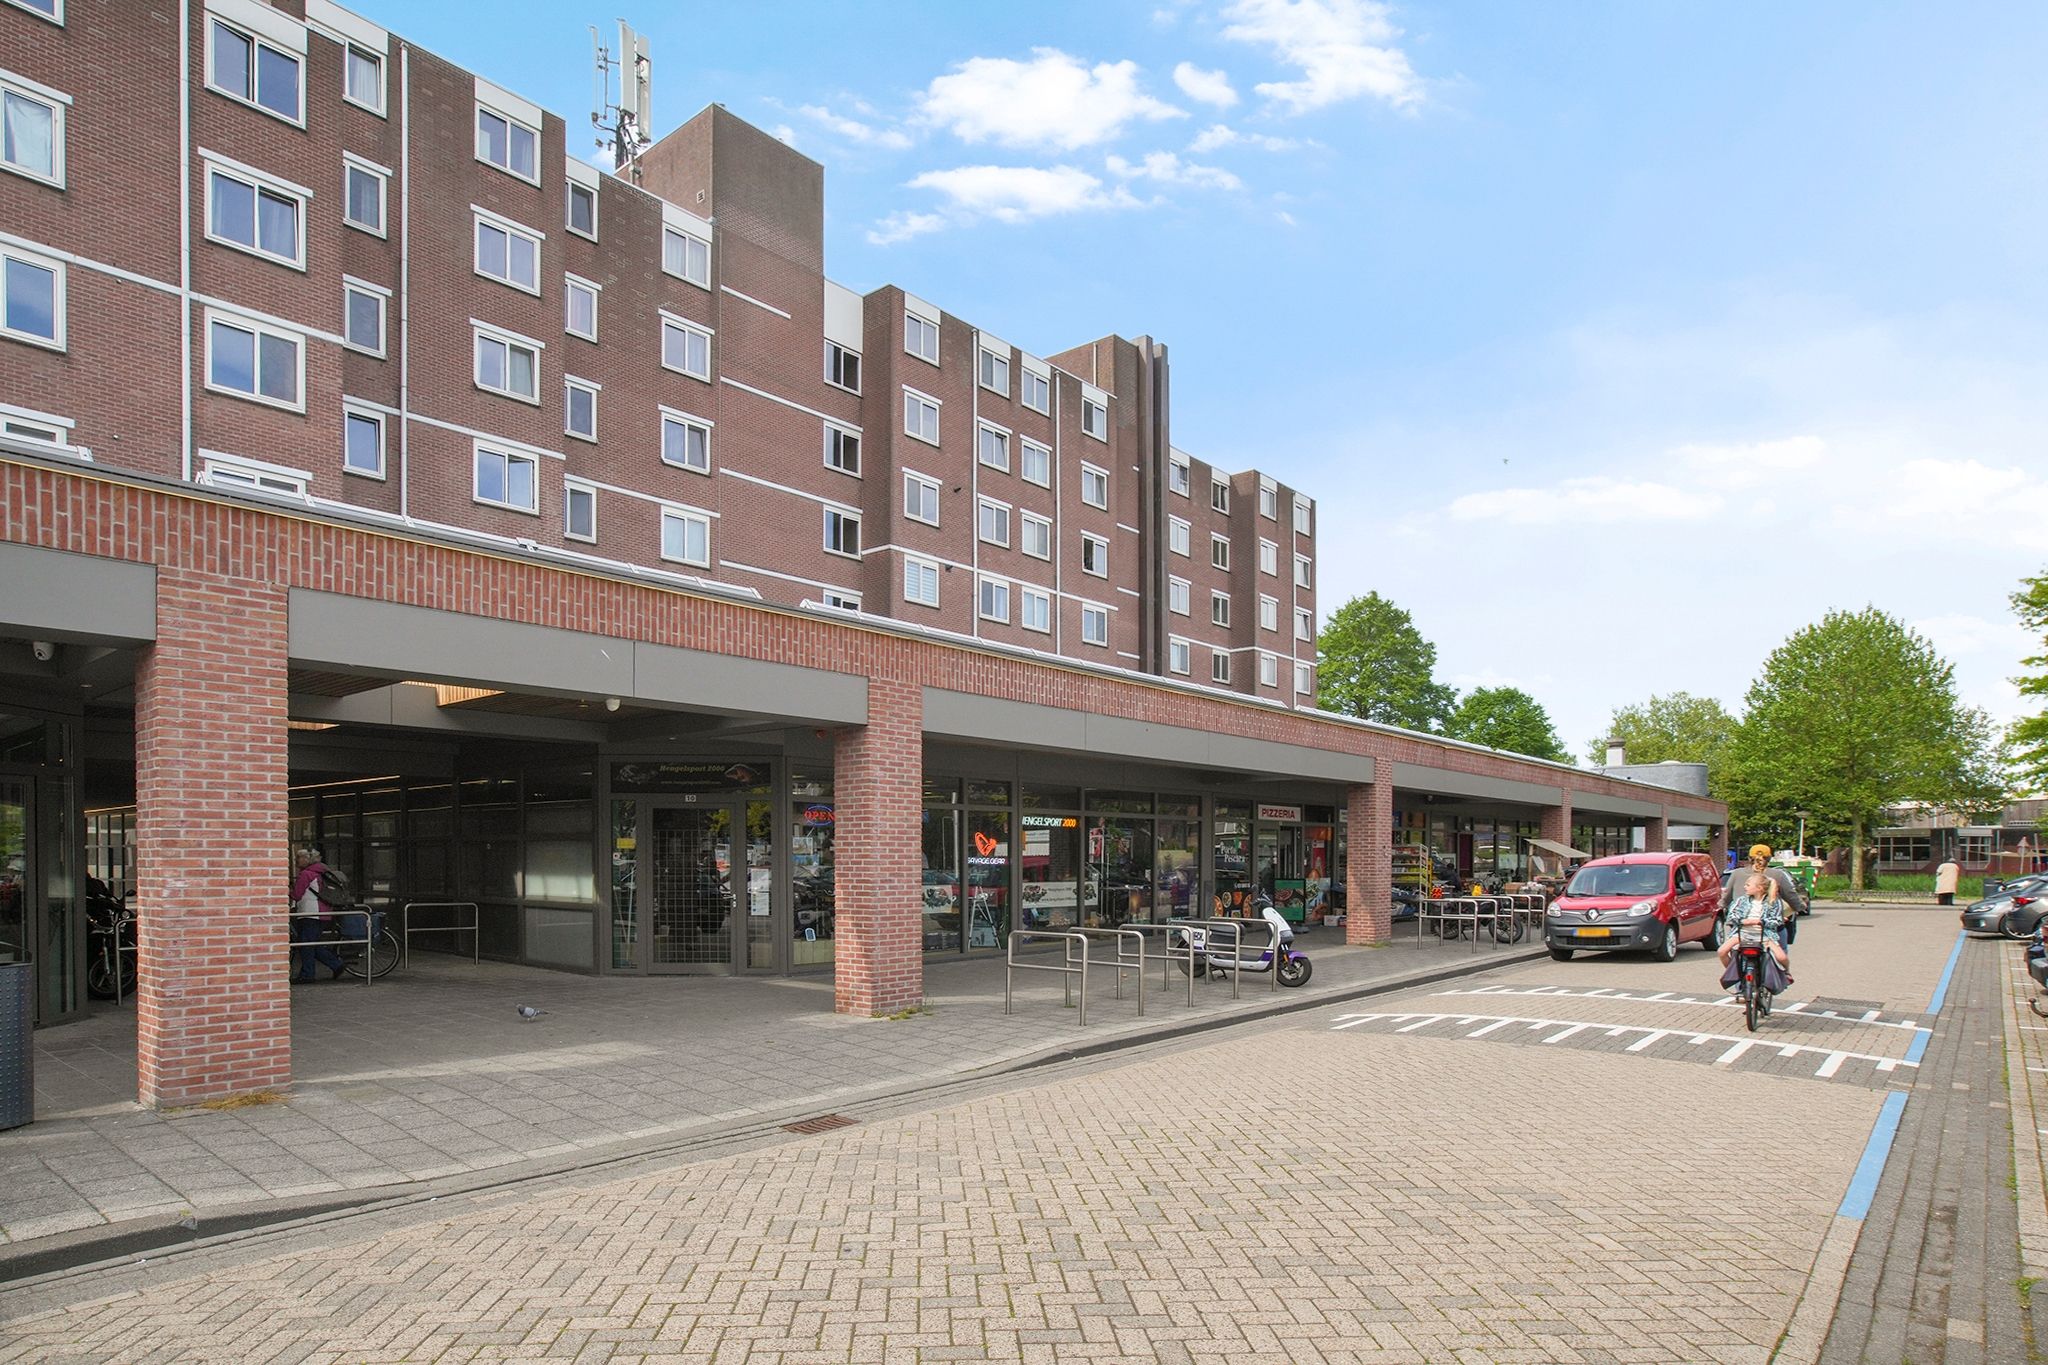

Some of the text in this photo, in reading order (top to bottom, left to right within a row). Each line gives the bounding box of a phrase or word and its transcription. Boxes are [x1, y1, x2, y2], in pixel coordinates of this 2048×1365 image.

[803, 810, 835, 821] OPEN
[1261, 808, 1296, 819] PIZZERIA
[1062, 818, 1077, 828] 2000
